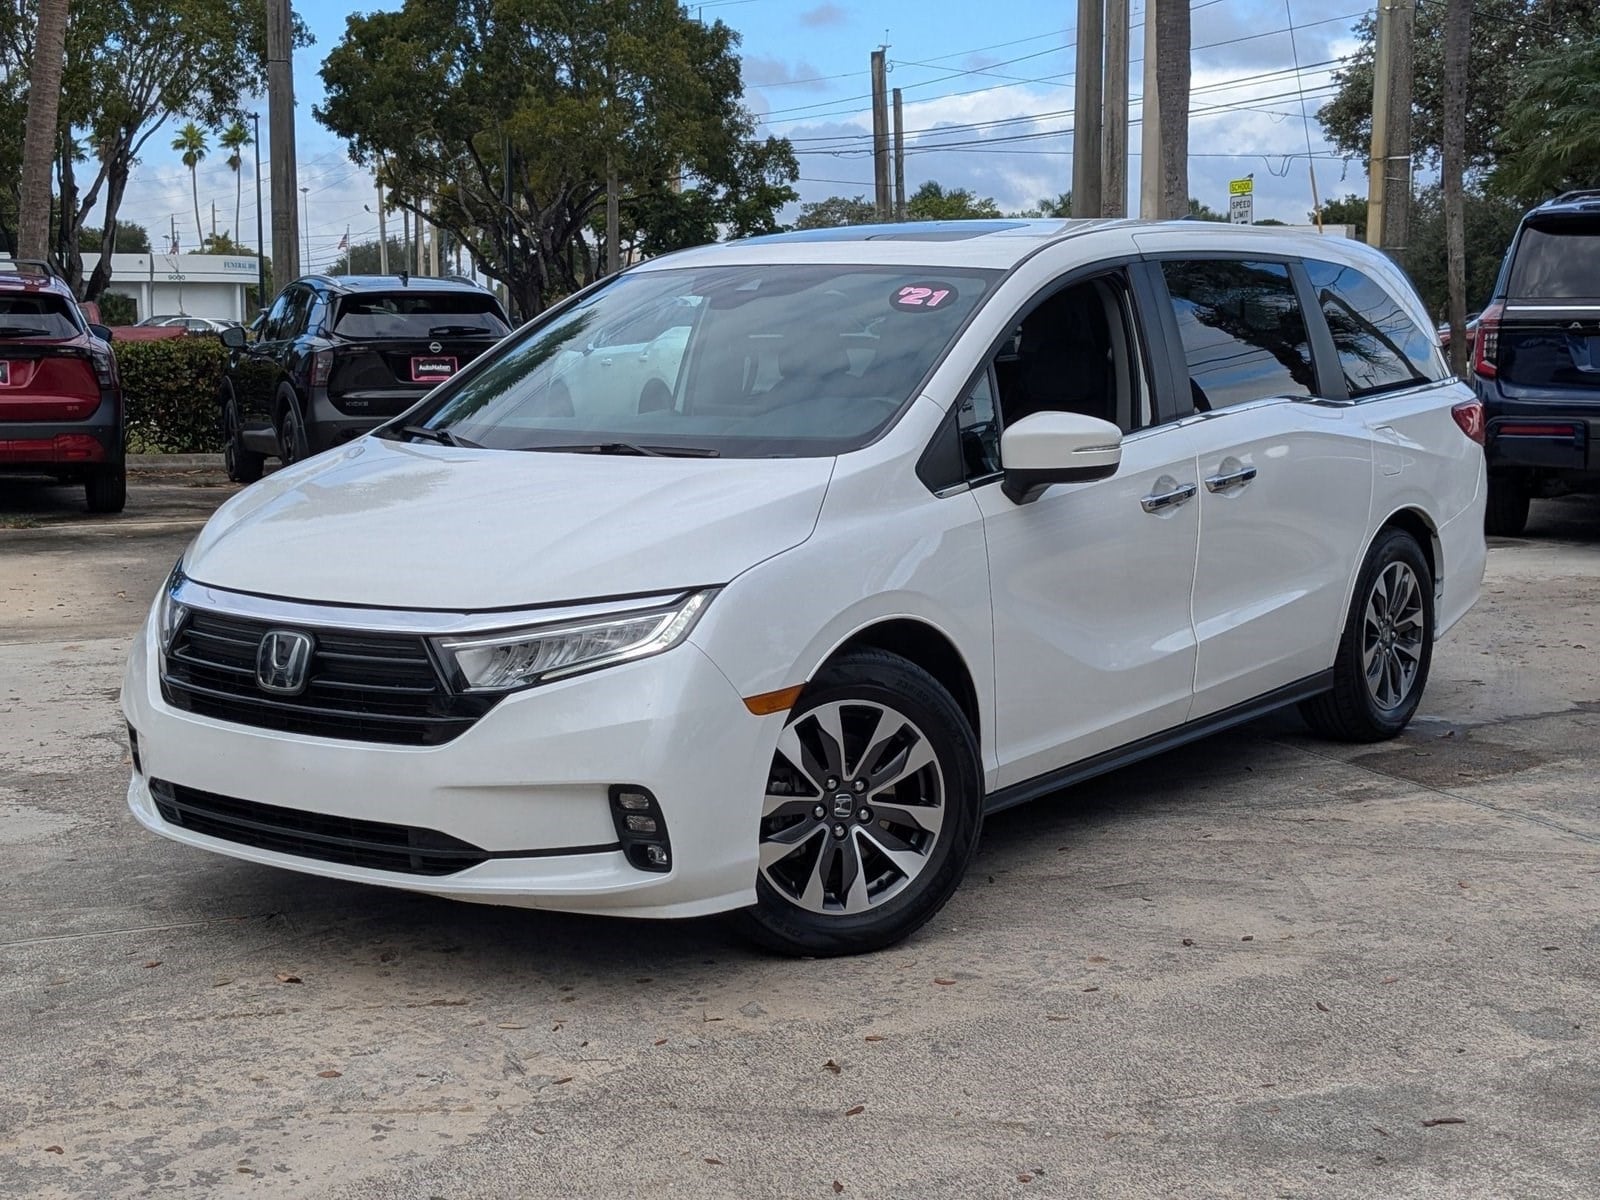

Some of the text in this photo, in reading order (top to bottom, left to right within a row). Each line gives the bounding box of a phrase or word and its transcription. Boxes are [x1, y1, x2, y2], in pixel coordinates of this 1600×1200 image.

[1231, 182, 1250, 191] SCHOOL
[1232, 200, 1250, 209] SPEED
[1233, 211, 1248, 219] LIMIT
[419, 364, 451, 372] AutoNation
